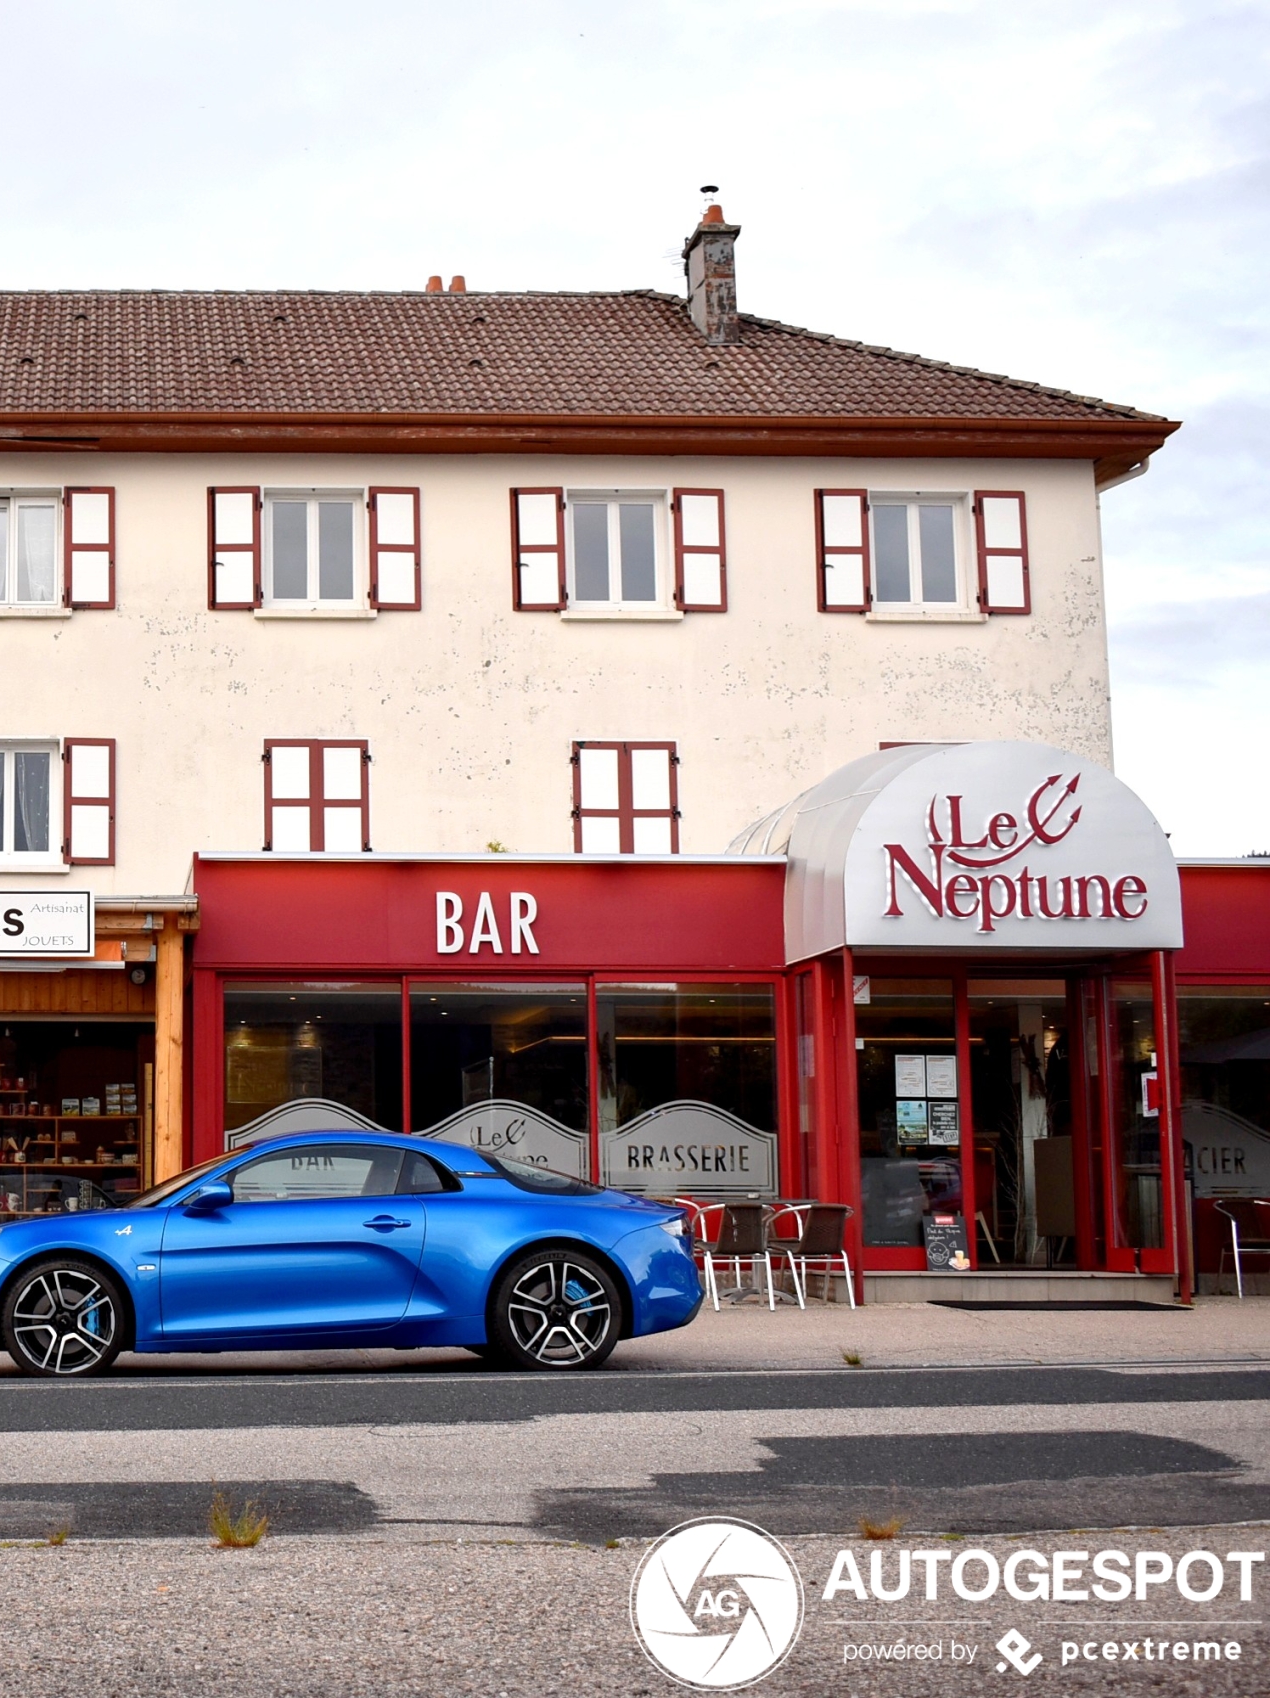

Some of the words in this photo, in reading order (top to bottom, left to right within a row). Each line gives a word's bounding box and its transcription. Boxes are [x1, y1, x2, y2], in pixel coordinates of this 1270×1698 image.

[945, 795, 1019, 849] Le
[882, 843, 1149, 932] Neptune
[30, 902, 85, 914] Artisanat
[435, 891, 540, 955] BAR
[22, 935, 74, 947] JOUETS
[476, 1126, 503, 1147] Le
[627, 1144, 750, 1172] BRASSERIE
